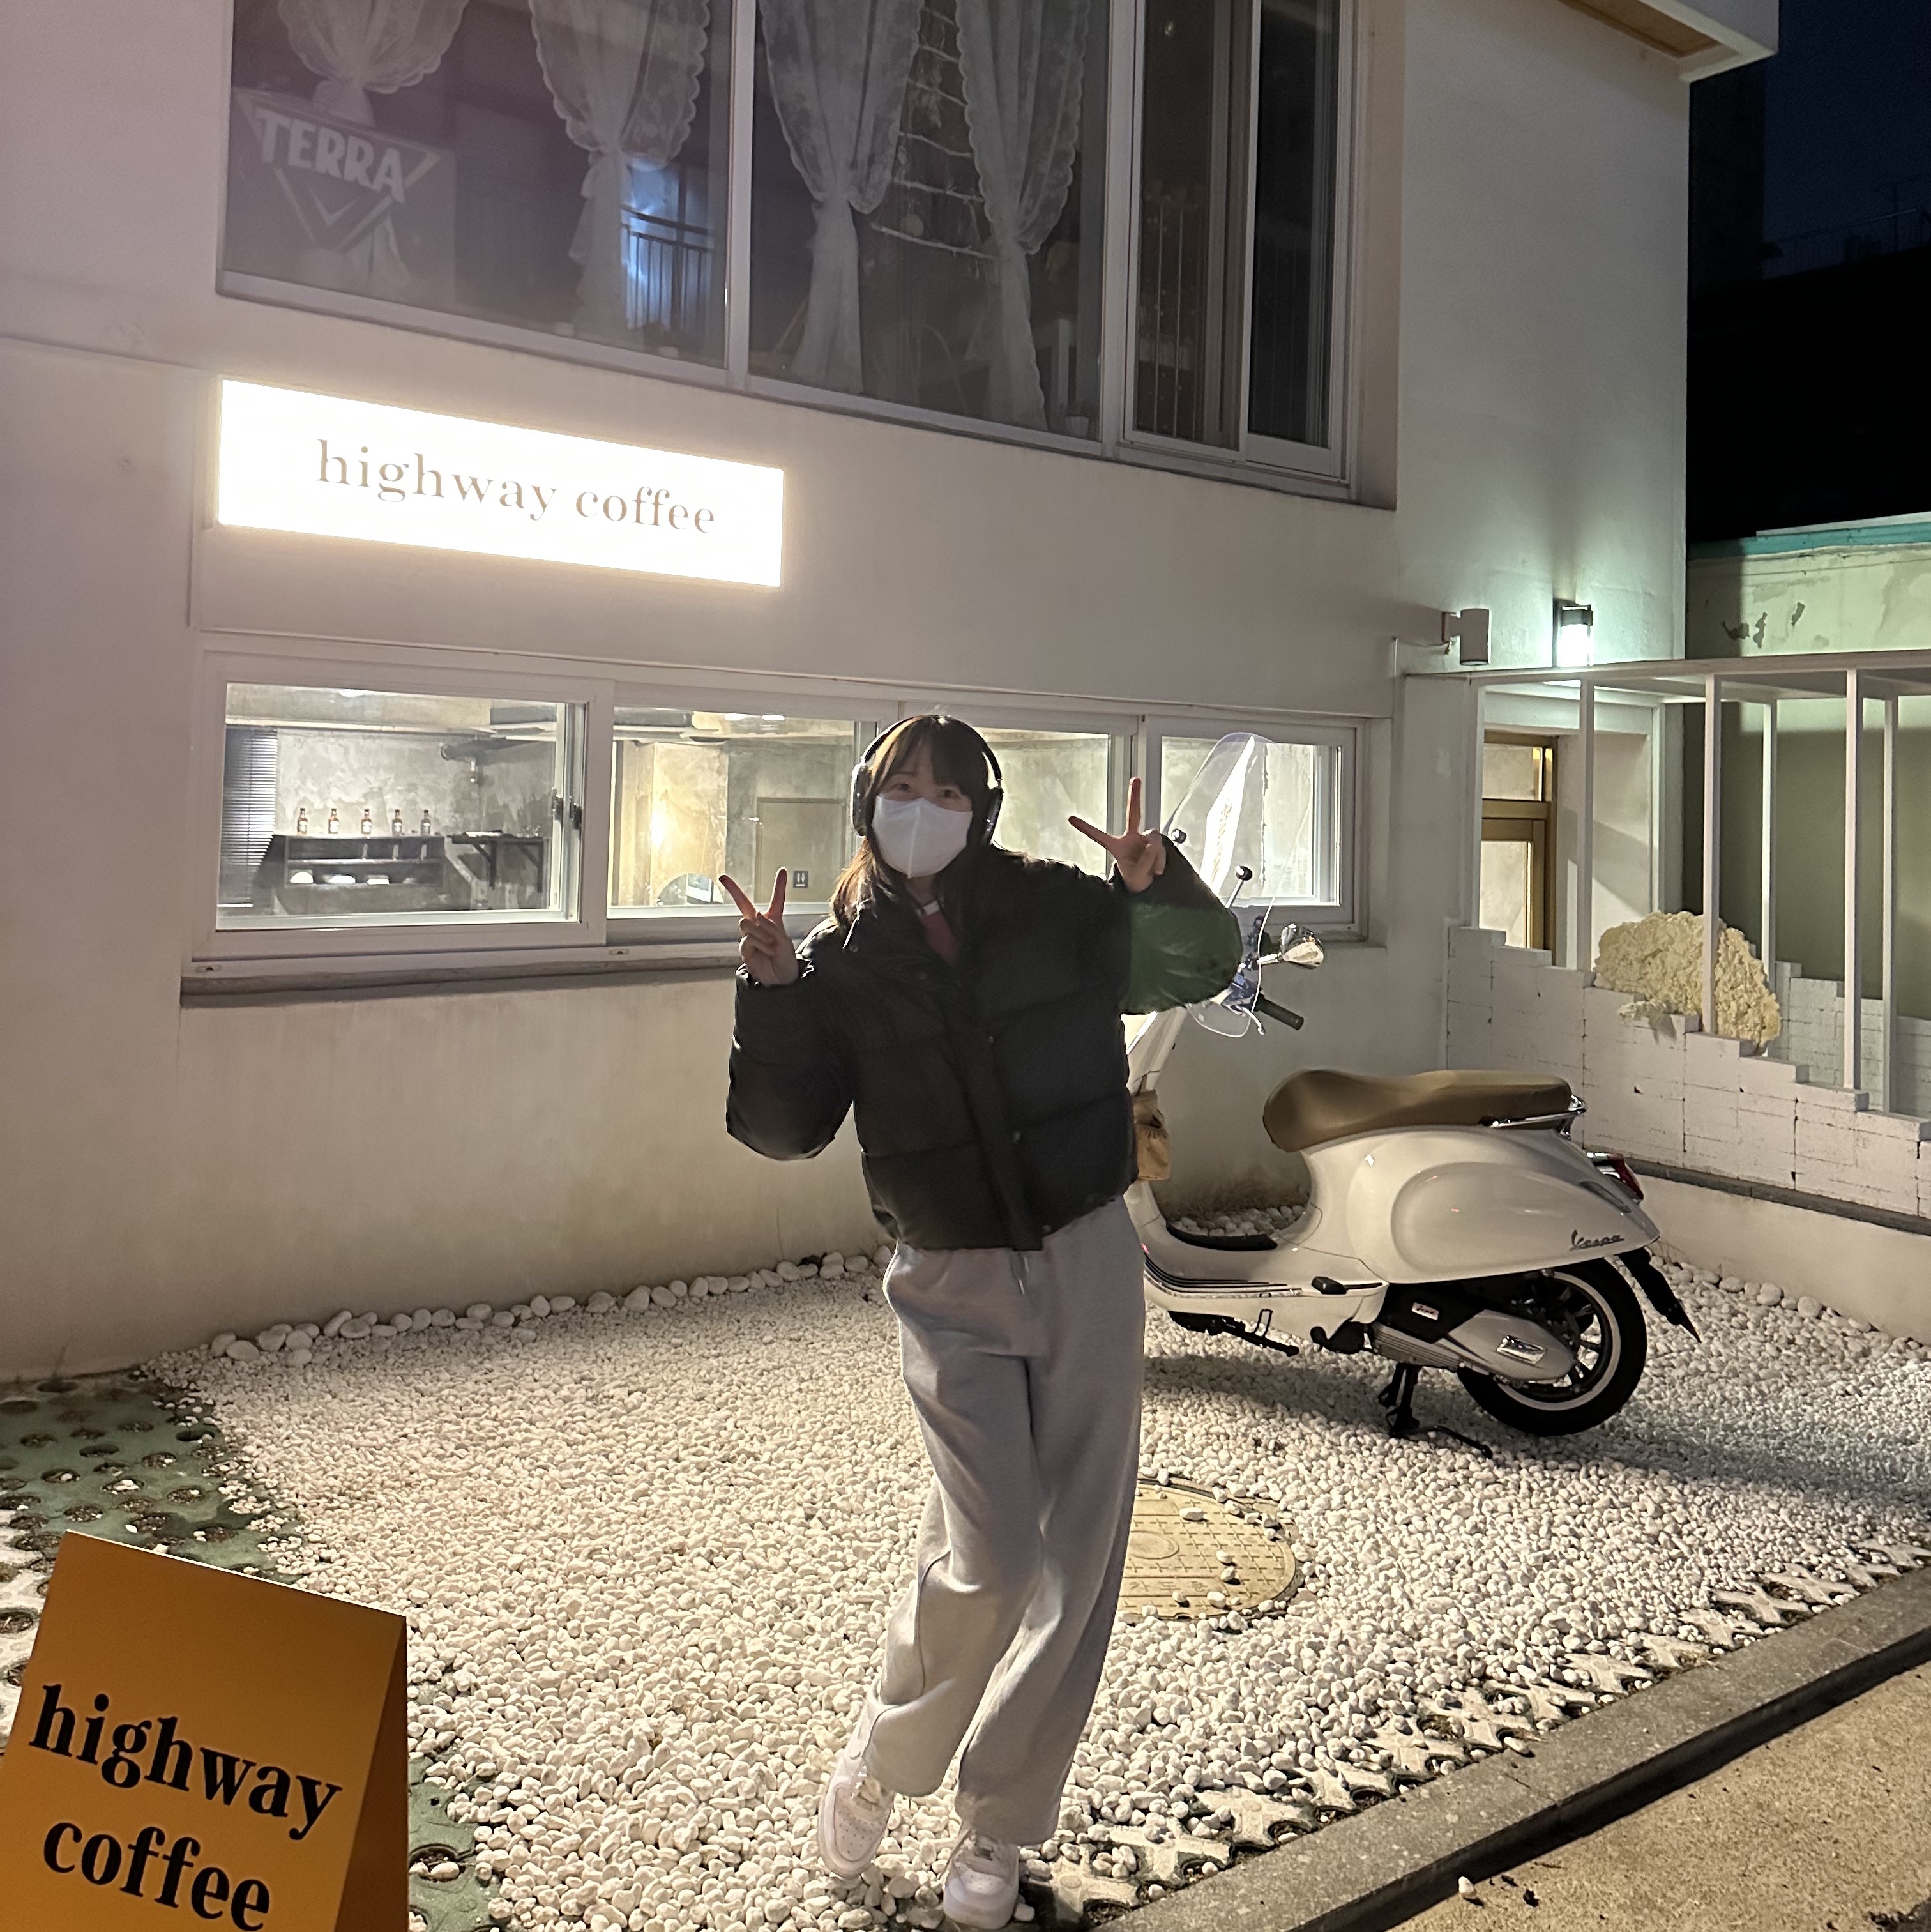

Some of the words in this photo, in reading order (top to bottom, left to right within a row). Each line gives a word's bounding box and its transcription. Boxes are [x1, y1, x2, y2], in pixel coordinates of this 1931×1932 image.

[255, 107, 405, 204] TERRA
[316, 438, 557, 521] highway
[575, 486, 715, 533] coffee
[1570, 1229, 1624, 1251] Vespa
[29, 1684, 342, 1841] highway
[43, 1822, 270, 1931] coffee
